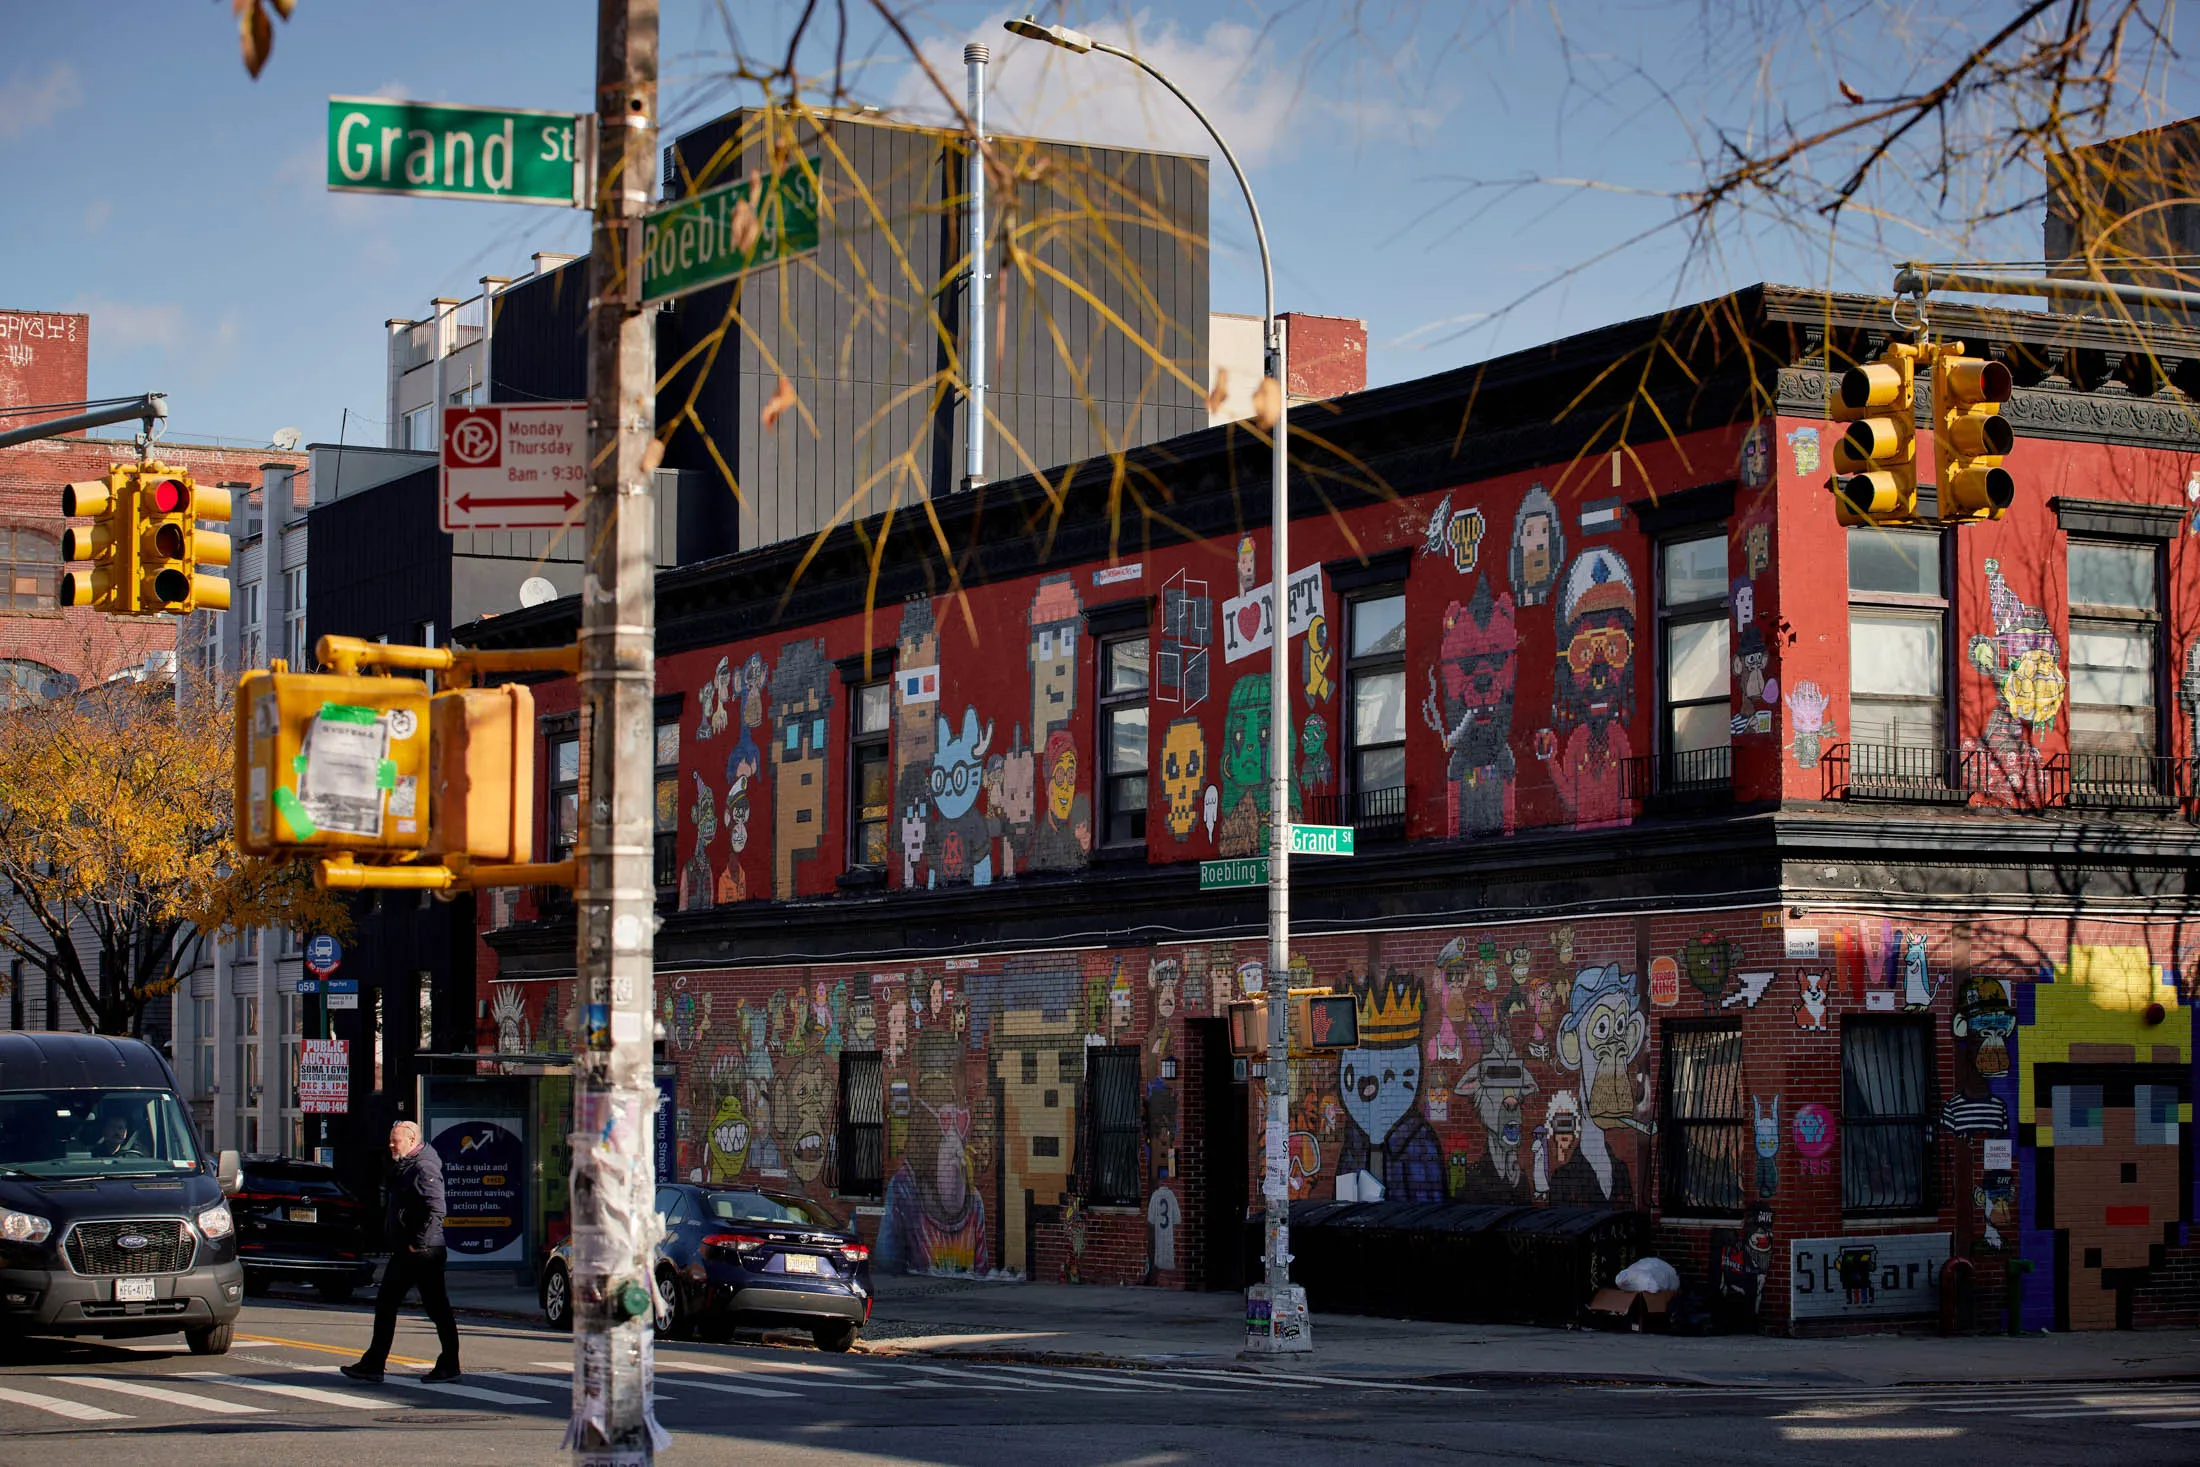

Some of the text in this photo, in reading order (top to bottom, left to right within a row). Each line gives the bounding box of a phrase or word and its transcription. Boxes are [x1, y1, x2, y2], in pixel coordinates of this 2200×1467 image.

[337, 112, 575, 190] Grand St
[644, 190, 778, 283] Roeblg
[509, 421, 564, 437] Monday
[509, 440, 574, 456] Thursday
[508, 467, 538, 482] 8am
[1225, 610, 1239, 650] I
[1291, 829, 1352, 851] Grand St
[1201, 861, 1257, 884] Roebling
[1652, 979, 1677, 995] KING
[306, 1040, 345, 1053] PUBLIC
[302, 1052, 347, 1065] AUCTION
[301, 1065, 324, 1074] SOMA
[331, 1065, 348, 1074] GYM
[658, 1141, 668, 1173] Street
[445, 1162, 465, 1171] Take
[473, 1162, 491, 1173] quiz
[492, 1162, 508, 1171] and
[447, 1177, 460, 1185] get
[461, 1177, 480, 1185] your
[483, 1189, 515, 1198] savings
[479, 1202, 501, 1211] plan.
[1158, 1198, 1170, 1229] 3
